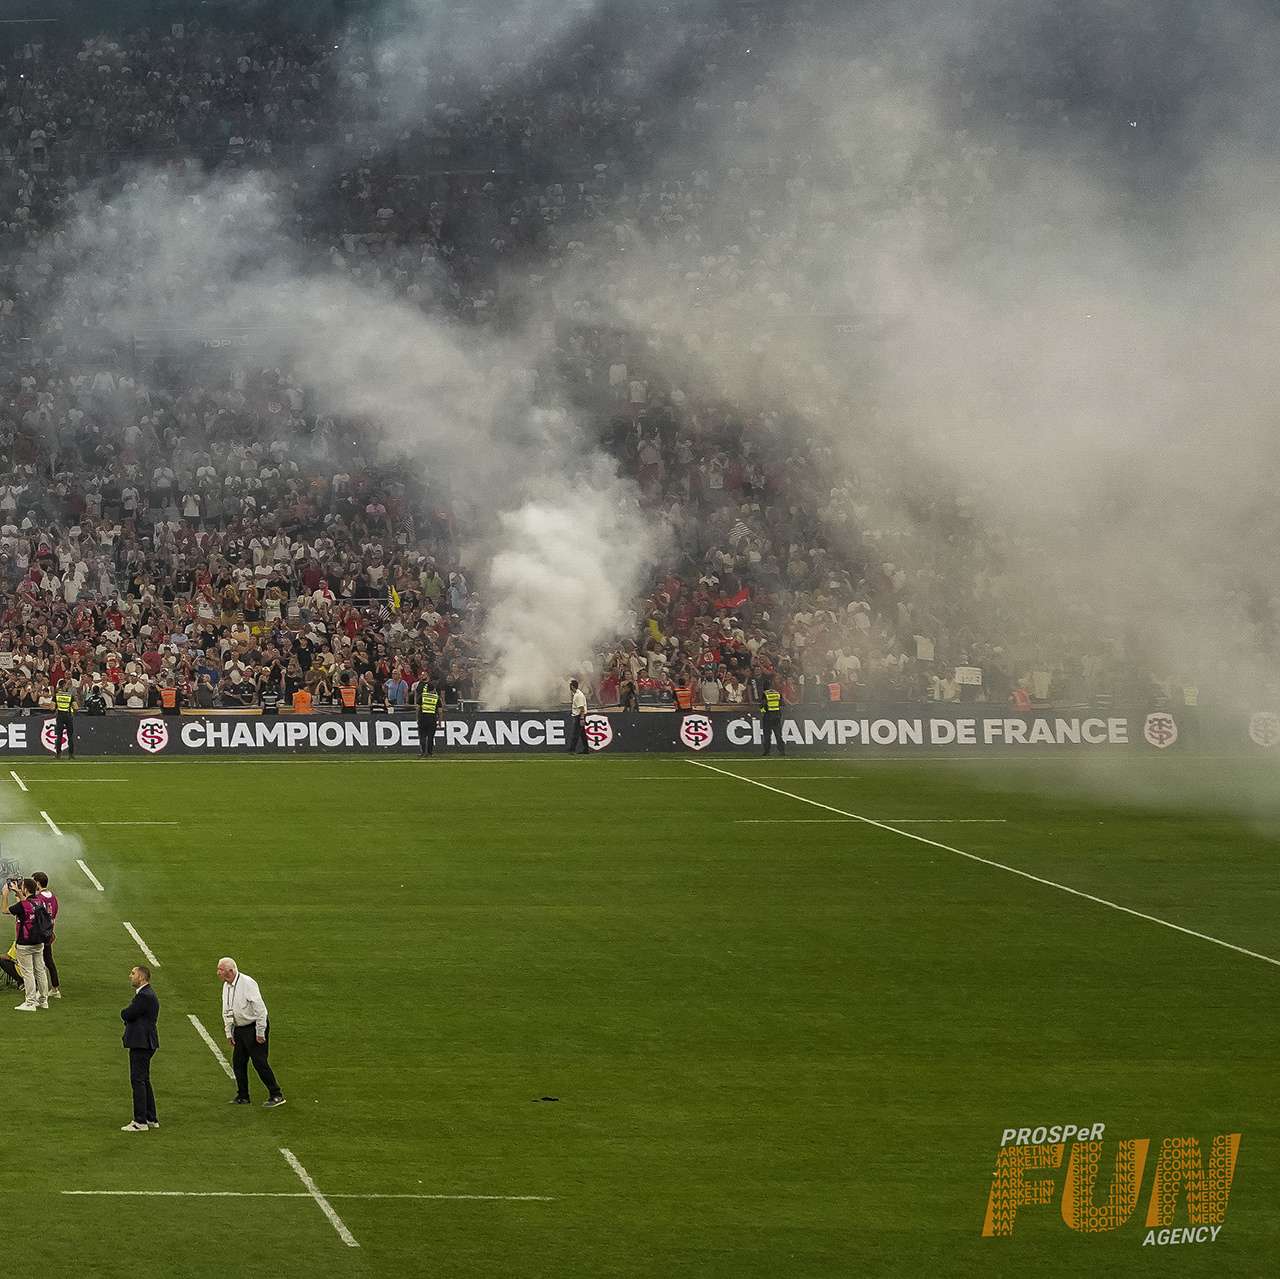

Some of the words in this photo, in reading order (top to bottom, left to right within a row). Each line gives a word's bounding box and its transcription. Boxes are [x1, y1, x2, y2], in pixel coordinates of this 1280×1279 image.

[181, 721, 369, 748] CHAMPION
[376, 721, 419, 746] DE
[930, 718, 976, 744] DE
[984, 718, 1129, 744] FRANCE
